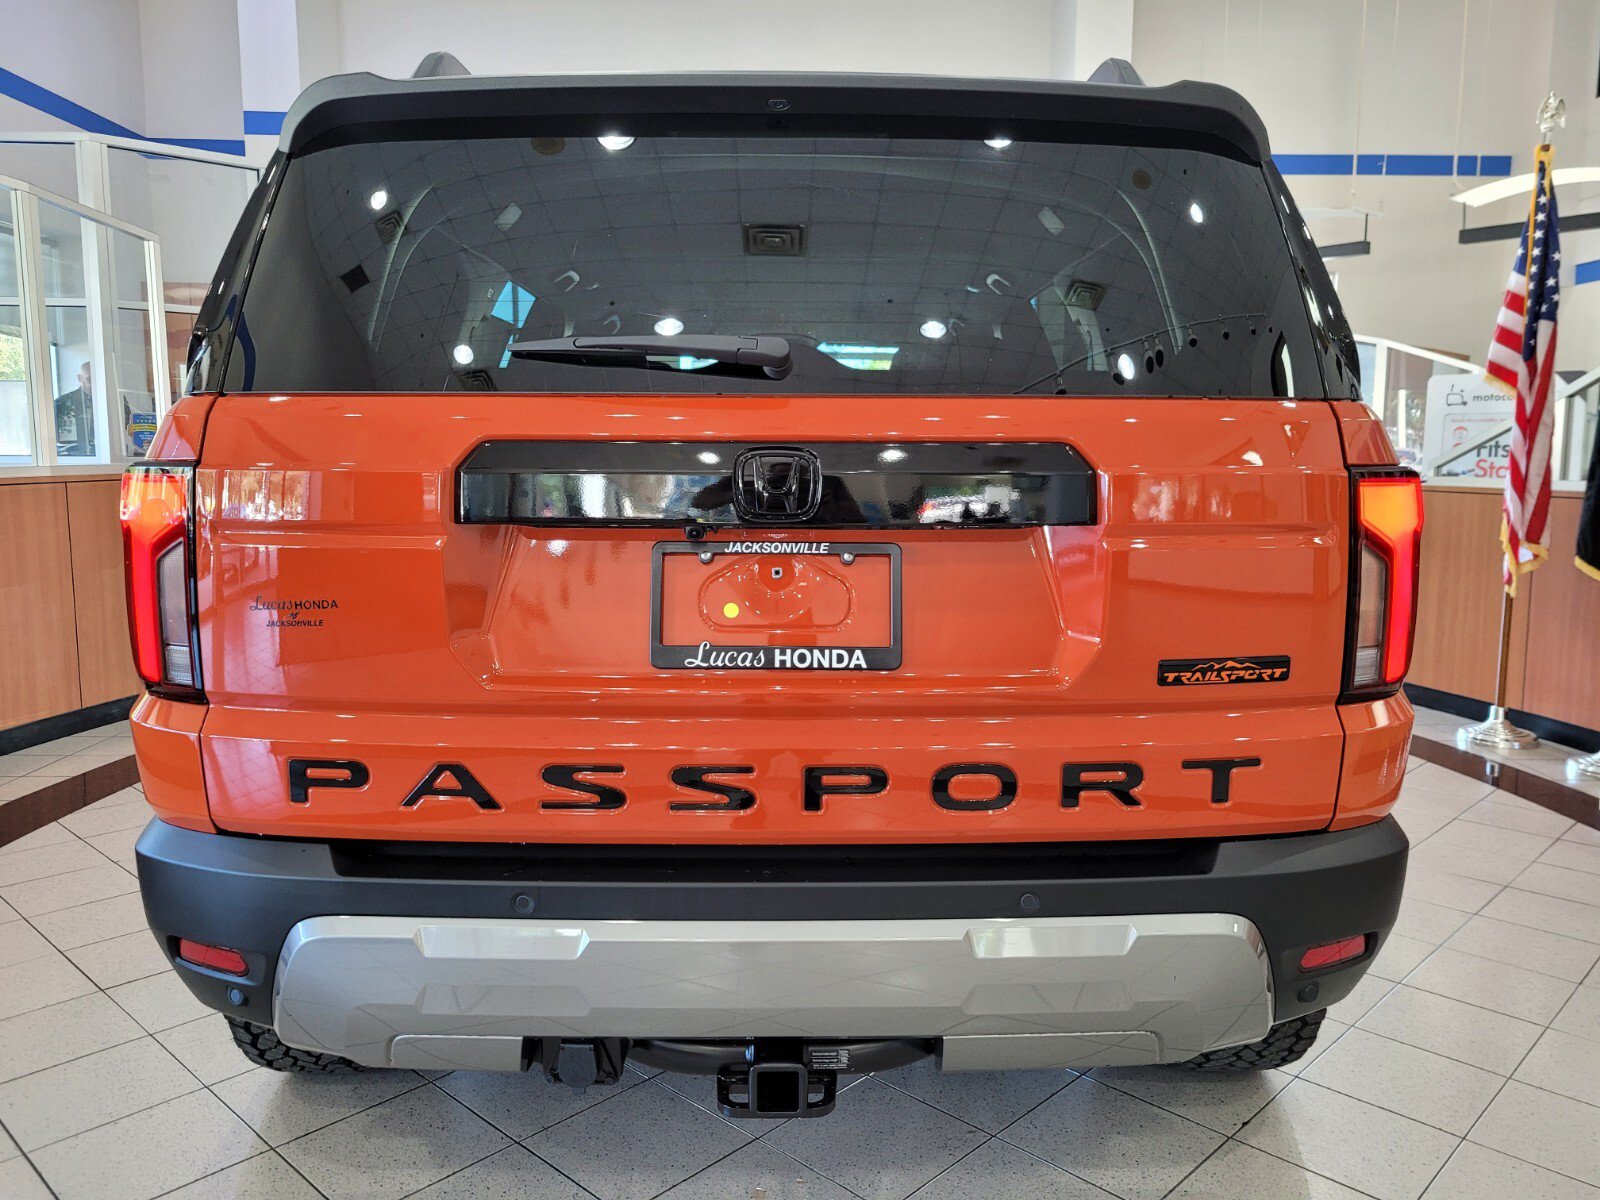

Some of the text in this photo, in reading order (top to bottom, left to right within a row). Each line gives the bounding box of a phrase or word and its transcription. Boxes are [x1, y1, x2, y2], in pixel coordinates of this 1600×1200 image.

[724, 542, 830, 554] JACKSONVILLE
[249, 595, 339, 611] Lucas HONDA
[266, 619, 324, 627] JACKSONVILLE
[684, 641, 867, 669] Lucas HONDA
[1163, 667, 1288, 685] TRAILSPORT
[288, 756, 1262, 811] PASSPORT
